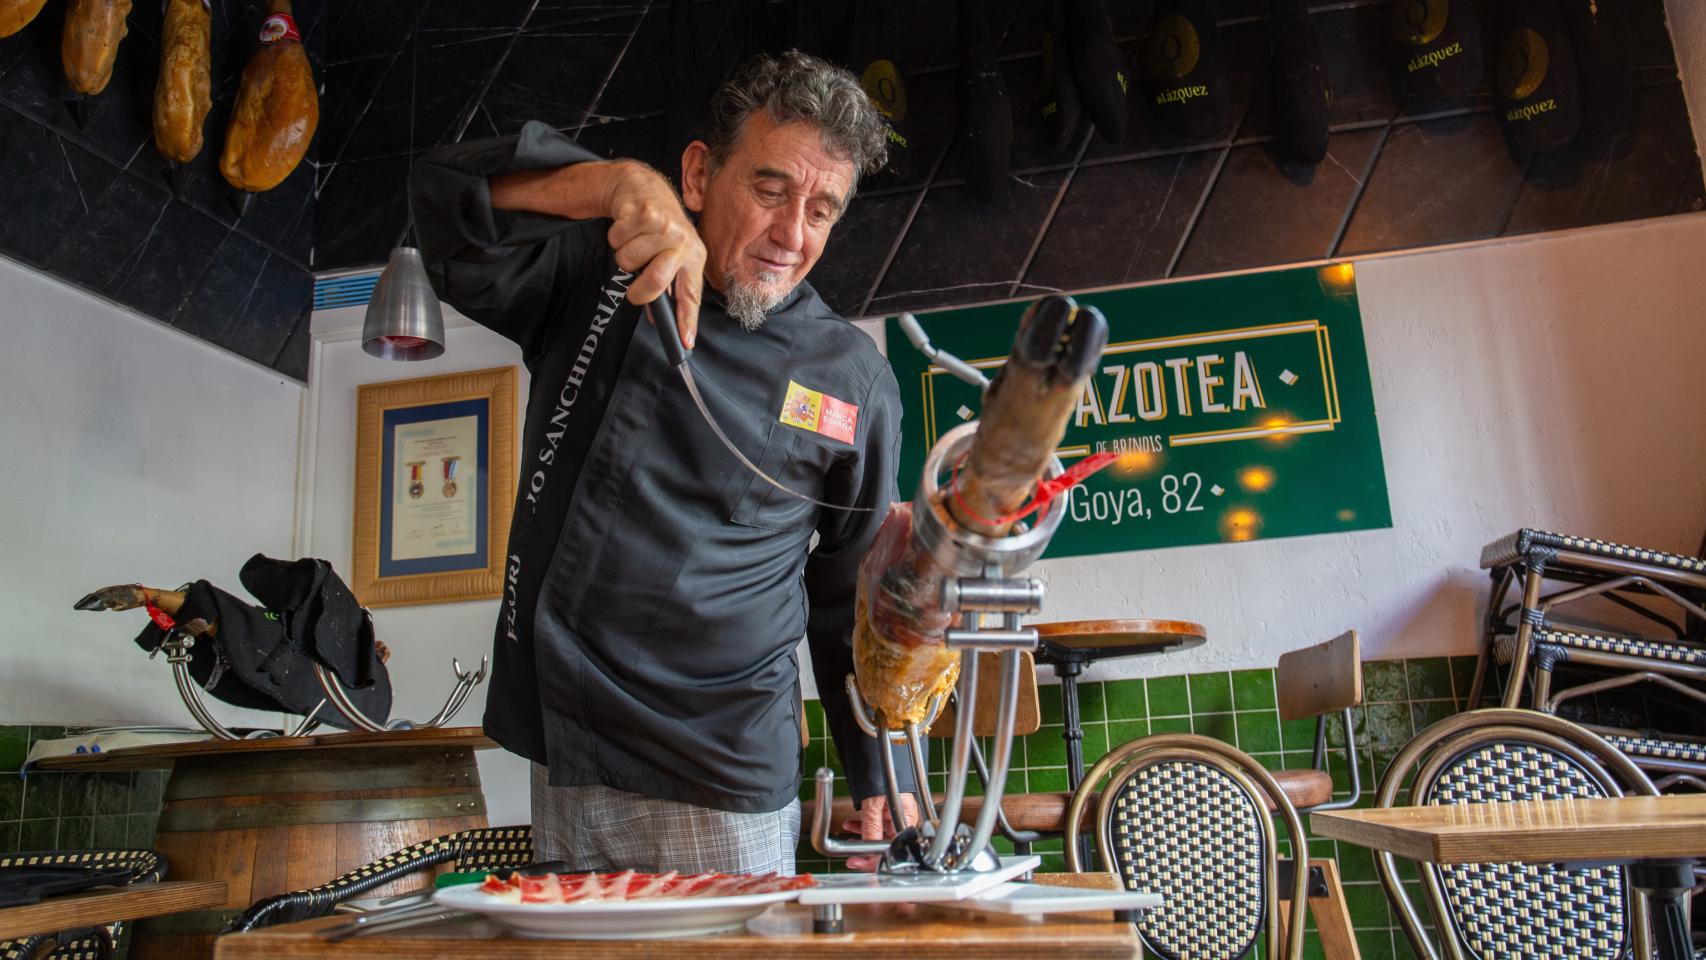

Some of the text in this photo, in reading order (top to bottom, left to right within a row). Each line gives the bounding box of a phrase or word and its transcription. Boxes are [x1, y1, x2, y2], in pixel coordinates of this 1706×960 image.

[538, 268, 634, 466] SANCHIDRIÁN
[1075, 351, 1266, 427] AZOTEA
[1113, 434, 1163, 457] BRINDIS
[1069, 472, 1204, 525] Goya, 82
